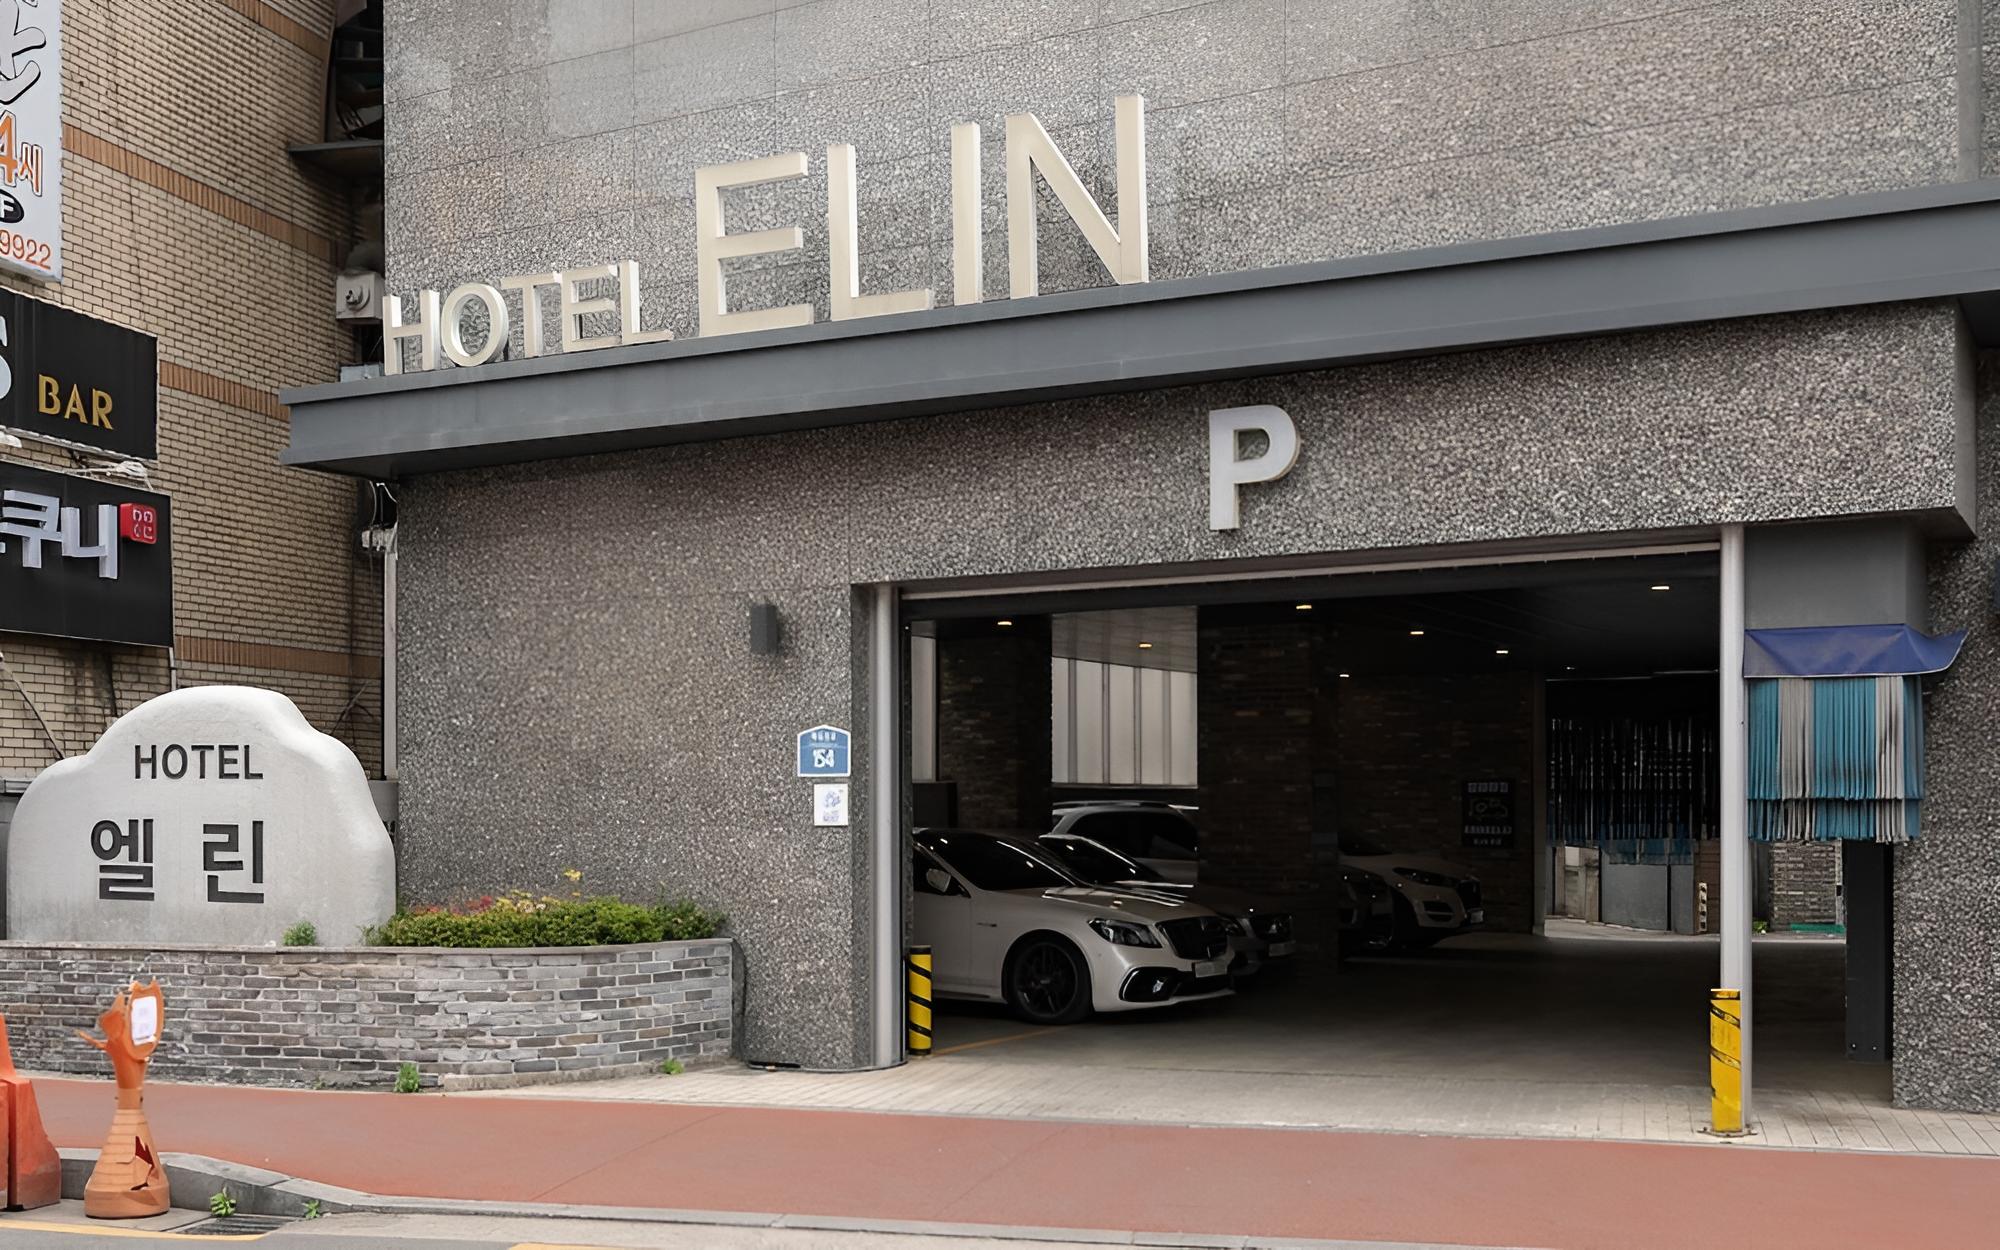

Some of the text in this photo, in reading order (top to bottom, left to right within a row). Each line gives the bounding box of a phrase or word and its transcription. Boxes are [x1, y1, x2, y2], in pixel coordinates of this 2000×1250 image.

[383, 93, 1150, 376] HOTEL ELIN
[38, 373, 115, 431] BAR
[1208, 404, 1301, 531] P
[0, 489, 118, 580] 쿠니
[133, 743, 264, 780] HOTEL
